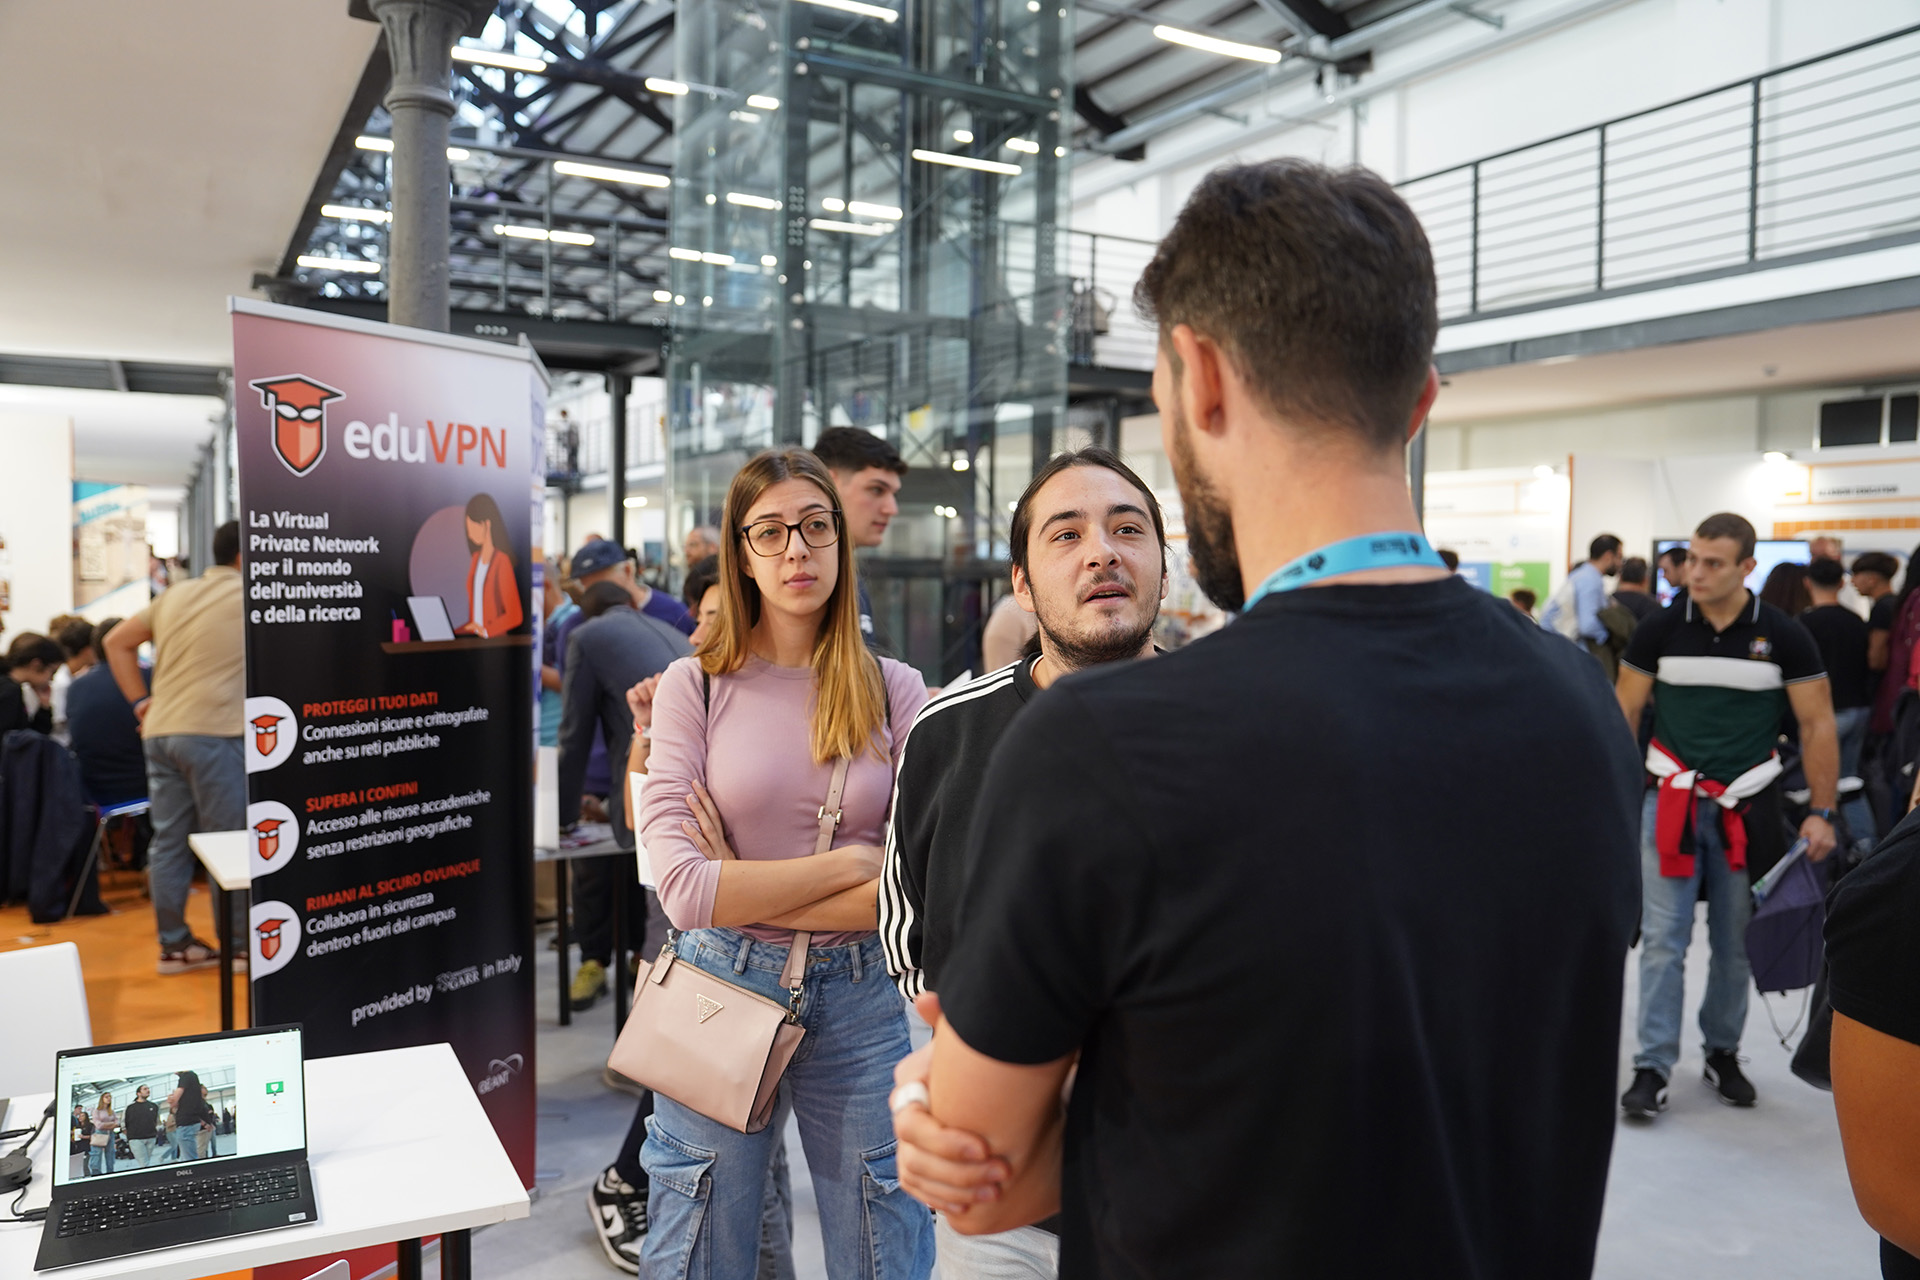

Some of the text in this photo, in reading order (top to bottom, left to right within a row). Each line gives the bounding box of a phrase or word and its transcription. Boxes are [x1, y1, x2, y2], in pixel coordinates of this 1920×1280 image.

[344, 412, 506, 468] eduVPN
[250, 510, 329, 529] La Virtual
[250, 534, 380, 553] Private Network
[250, 557, 352, 580] per il mondo
[250, 604, 361, 624] e della ricerca
[303, 691, 439, 718] PROTEGGI I TUOI DATI
[302, 706, 489, 742] Connessioni sicure e crittografate
[303, 732, 440, 765] anche su reti pubbliche
[306, 781, 418, 812] SUPERA I CONFINI
[306, 789, 491, 836] Accesso alle risorse accademiche
[306, 813, 473, 860] senza restrizioni geografiche
[306, 859, 481, 912] RIMANI AL SICURO OVUNQUE
[305, 892, 435, 935] Collabora in sicurezza
[306, 907, 457, 957] dentro e fuori dal campus
[351, 986, 415, 1027] provided
[415, 984, 434, 1004] by
[482, 963, 496, 980] in
[495, 953, 523, 974] Italy
[176, 1169, 194, 1177] DELL
